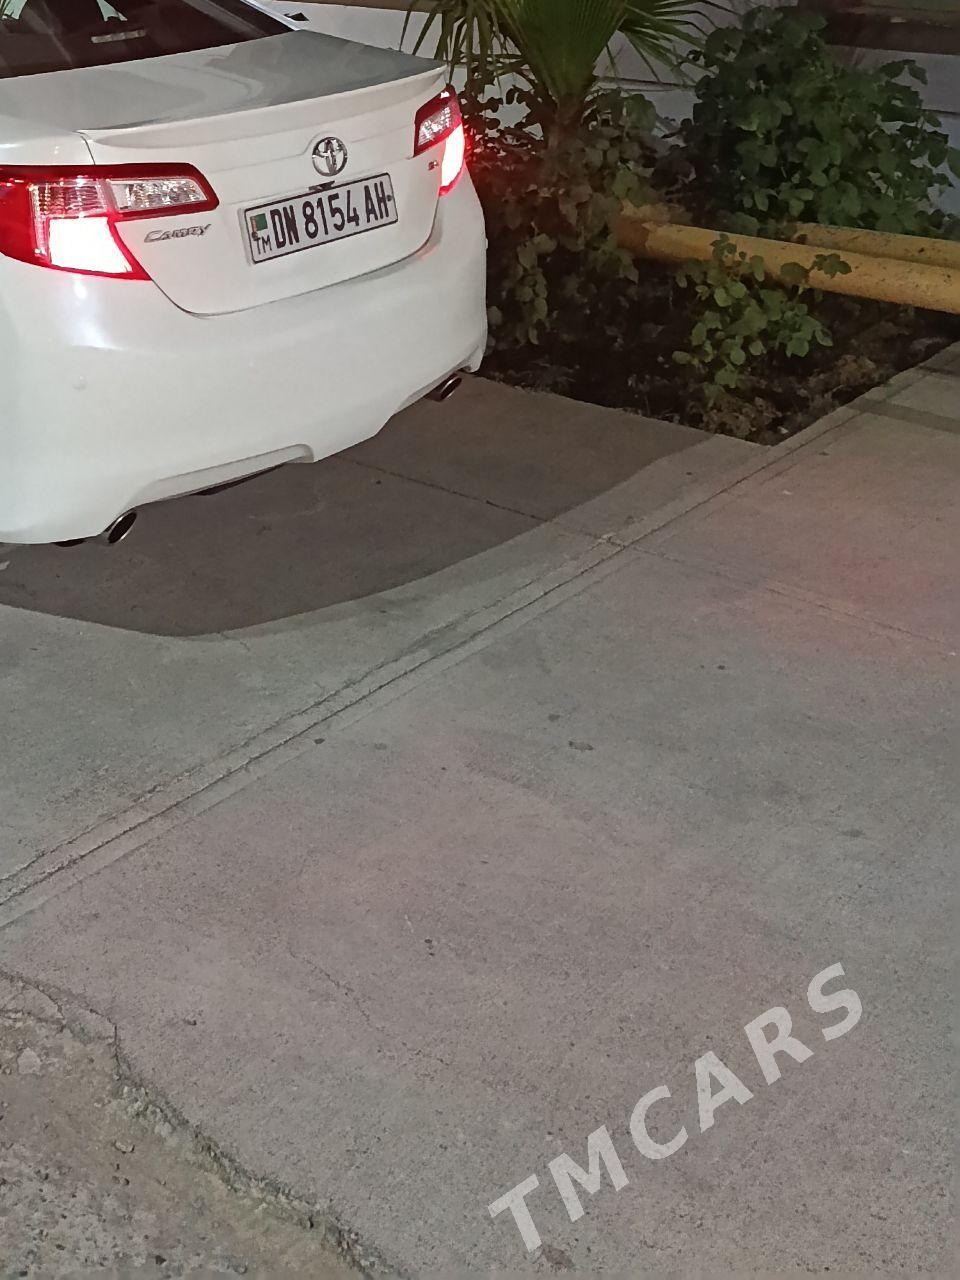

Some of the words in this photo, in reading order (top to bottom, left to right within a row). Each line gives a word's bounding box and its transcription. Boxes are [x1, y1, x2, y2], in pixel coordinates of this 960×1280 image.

[269, 204, 300, 249] DN
[302, 189, 360, 239] 8154
[364, 180, 390, 223] AH
[253, 234, 273, 255] TM
